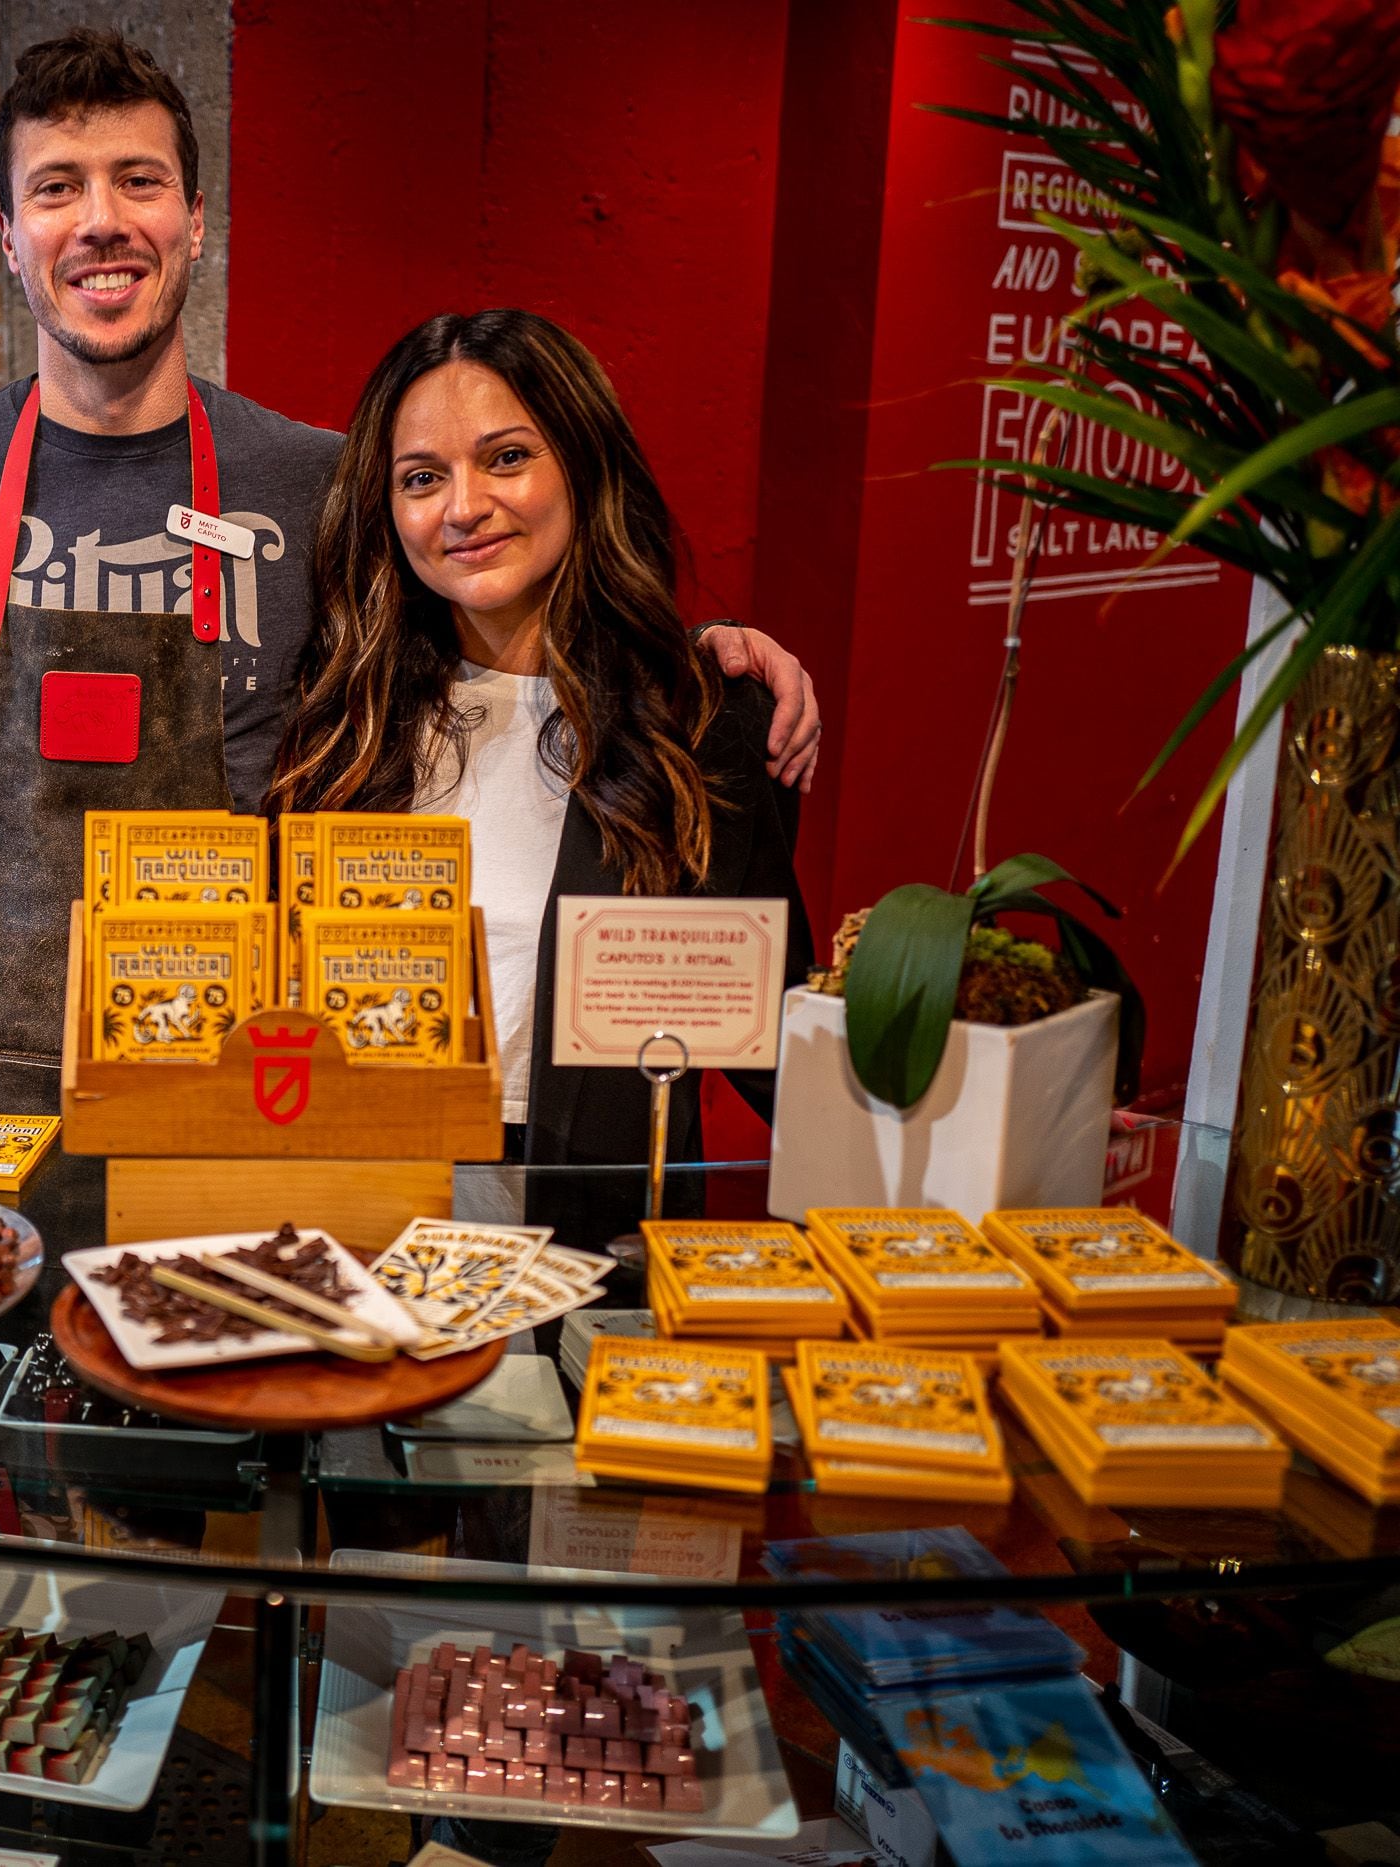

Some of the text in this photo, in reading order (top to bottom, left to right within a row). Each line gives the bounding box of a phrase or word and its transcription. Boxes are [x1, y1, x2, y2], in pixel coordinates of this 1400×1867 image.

[992, 244, 1060, 292] AND
[199, 520, 218, 531] MATT
[197, 528, 227, 542] CAPUTO
[1006, 522, 1080, 559] SALT
[1087, 521, 1160, 554] LAKE
[166, 849, 219, 860] WILD
[370, 850, 423, 862] WILD
[598, 928, 748, 945] WILD TRANQUILIDAD
[141, 945, 196, 957] WILD
[356, 948, 411, 960] WILD
[686, 953, 734, 967] RITUAL
[473, 1457, 521, 1468] HONEY
[999, 1812, 1124, 1842] to Chocolate
